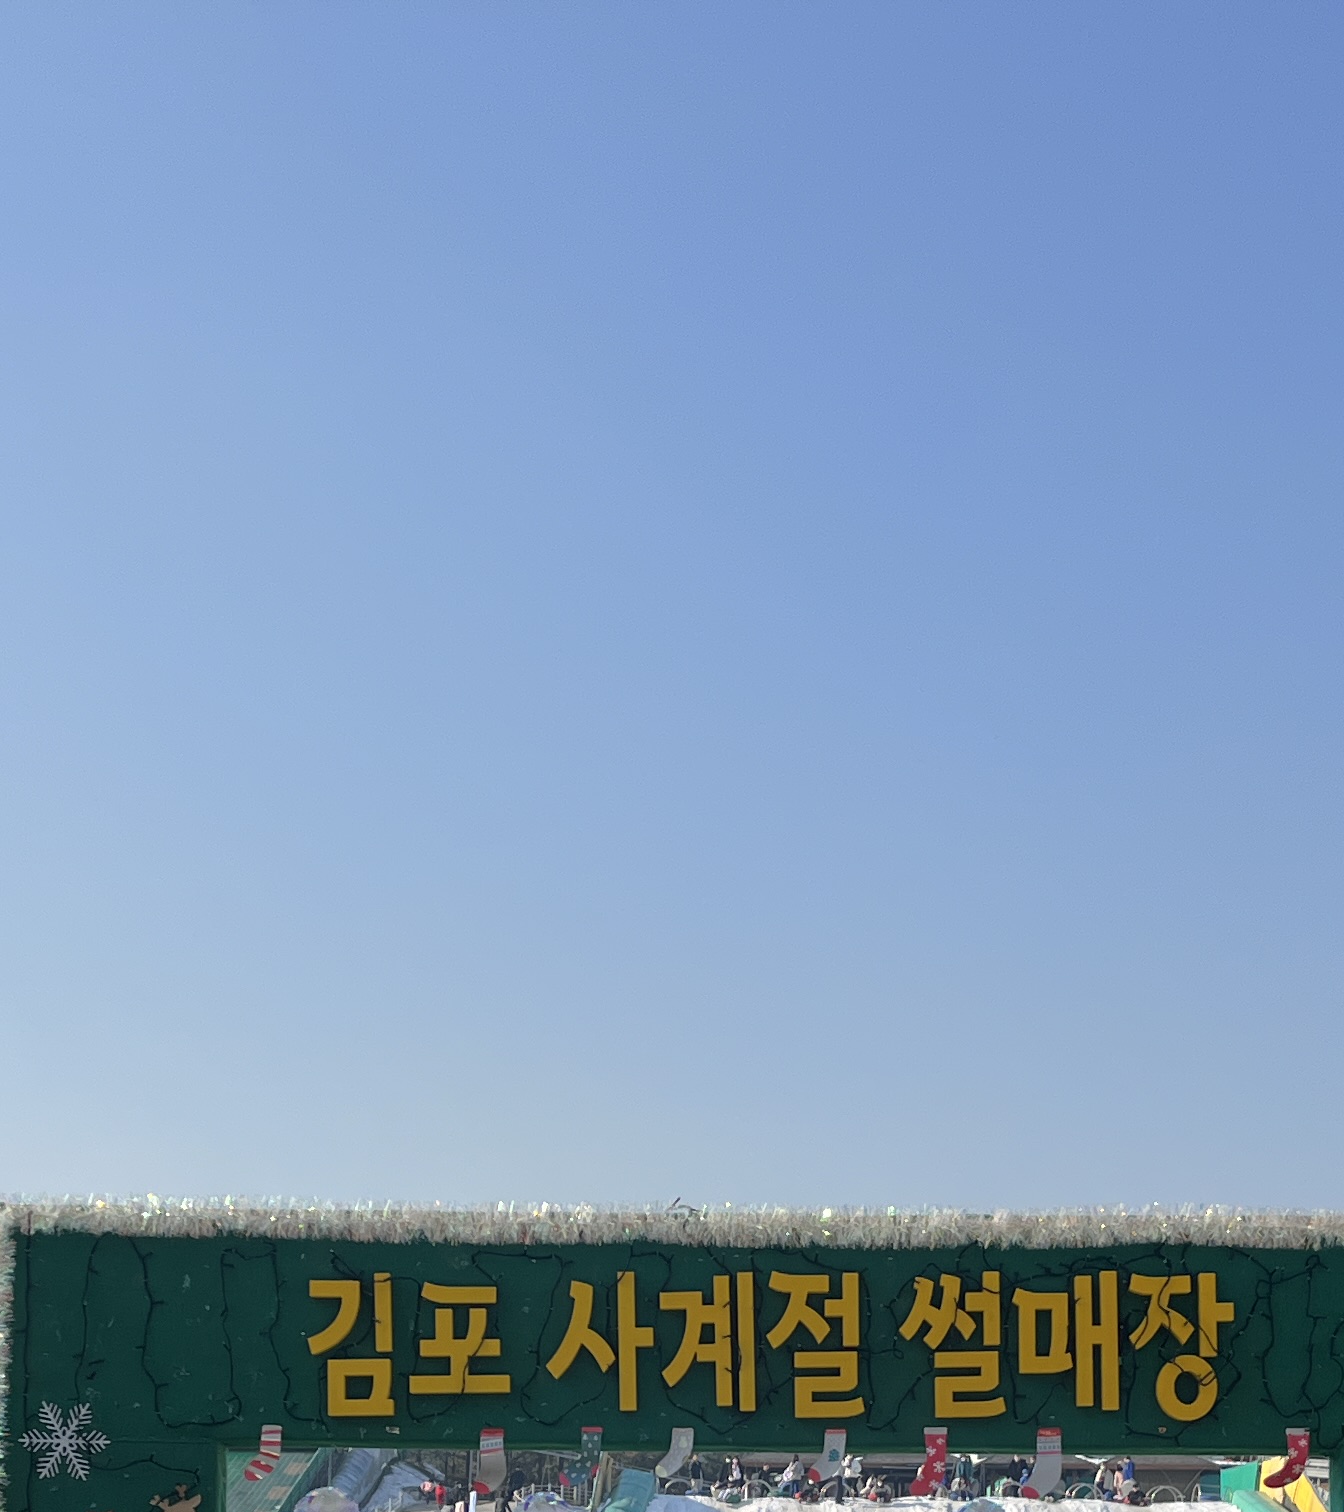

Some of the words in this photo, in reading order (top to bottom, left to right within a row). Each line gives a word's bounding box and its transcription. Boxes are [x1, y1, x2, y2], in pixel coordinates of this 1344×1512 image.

[307, 1272, 512, 1418] 김포
[545, 1270, 865, 1420] 사계절
[897, 1269, 1236, 1423] 썰매장
